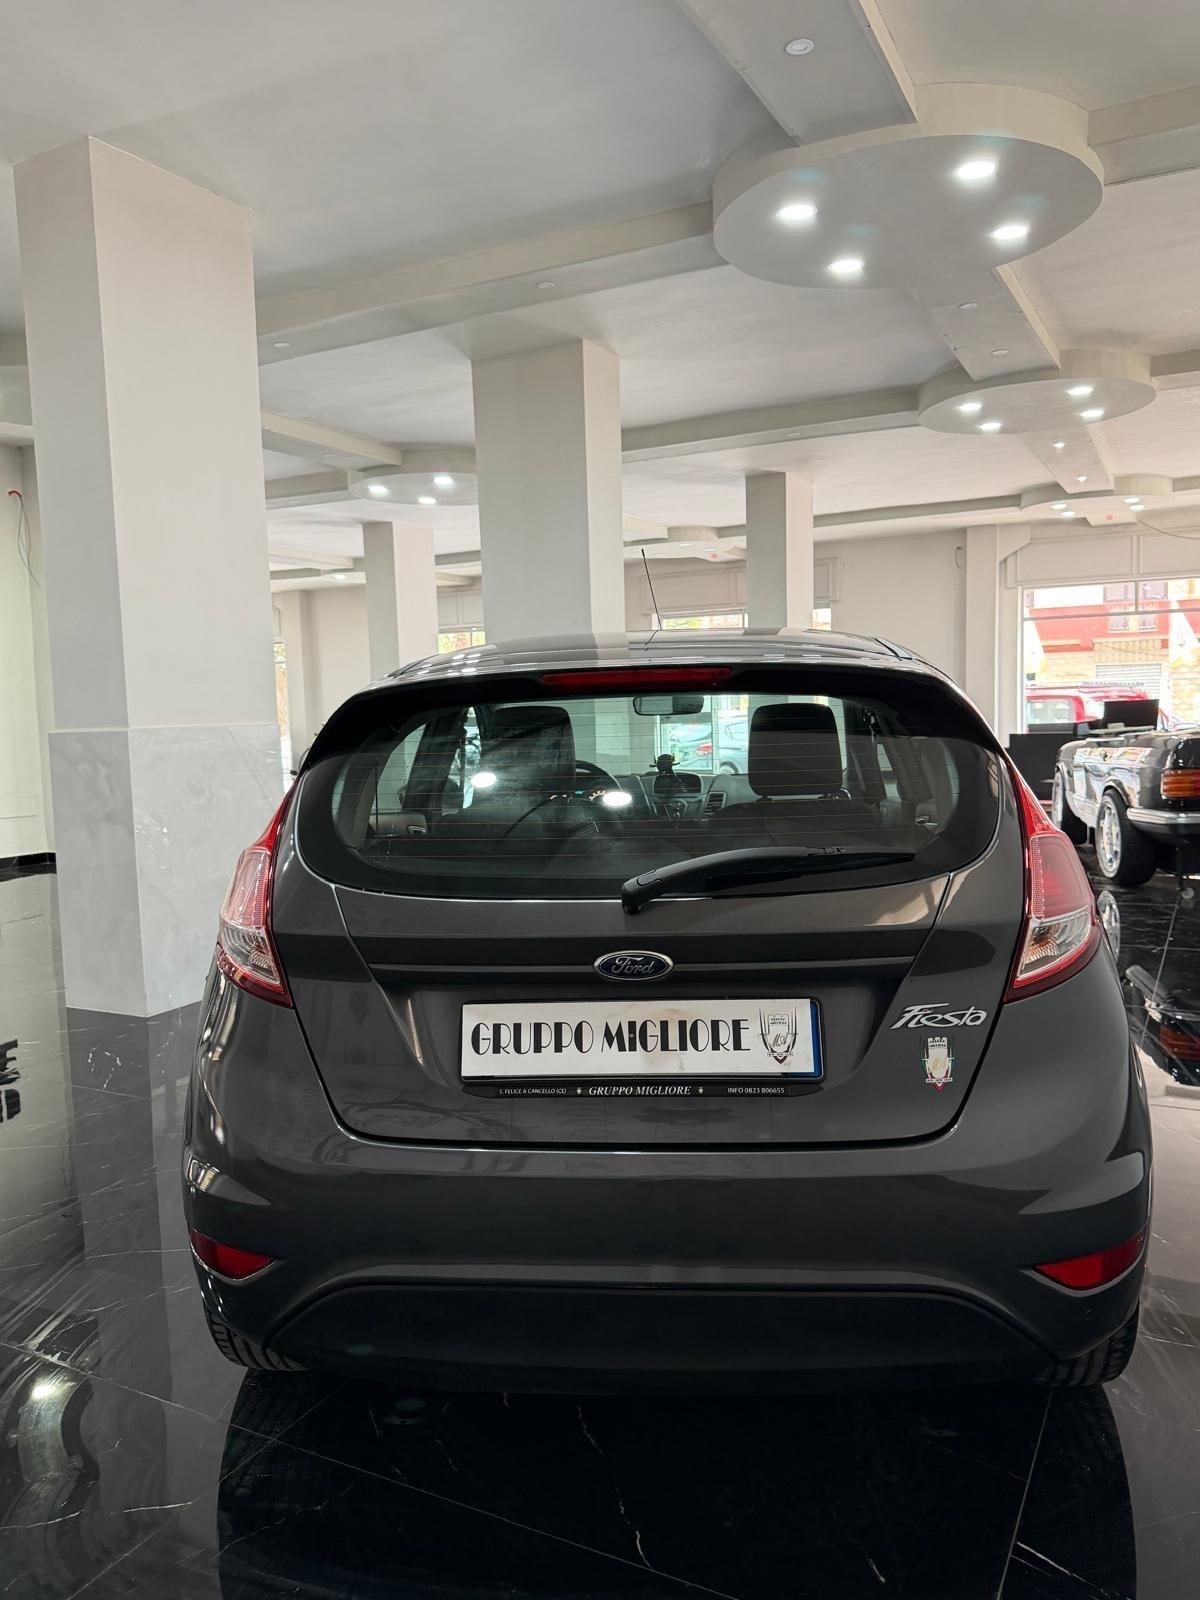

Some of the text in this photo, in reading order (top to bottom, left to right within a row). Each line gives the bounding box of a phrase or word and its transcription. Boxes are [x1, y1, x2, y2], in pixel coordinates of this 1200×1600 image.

[611, 955, 655, 974] Ford
[889, 1002, 988, 1030] Fiesta
[470, 1020, 595, 1056] GRUPPO
[600, 1018, 751, 1053] MIGLIORE
[588, 1085, 692, 1096] GRUPPO MIGLIORE
